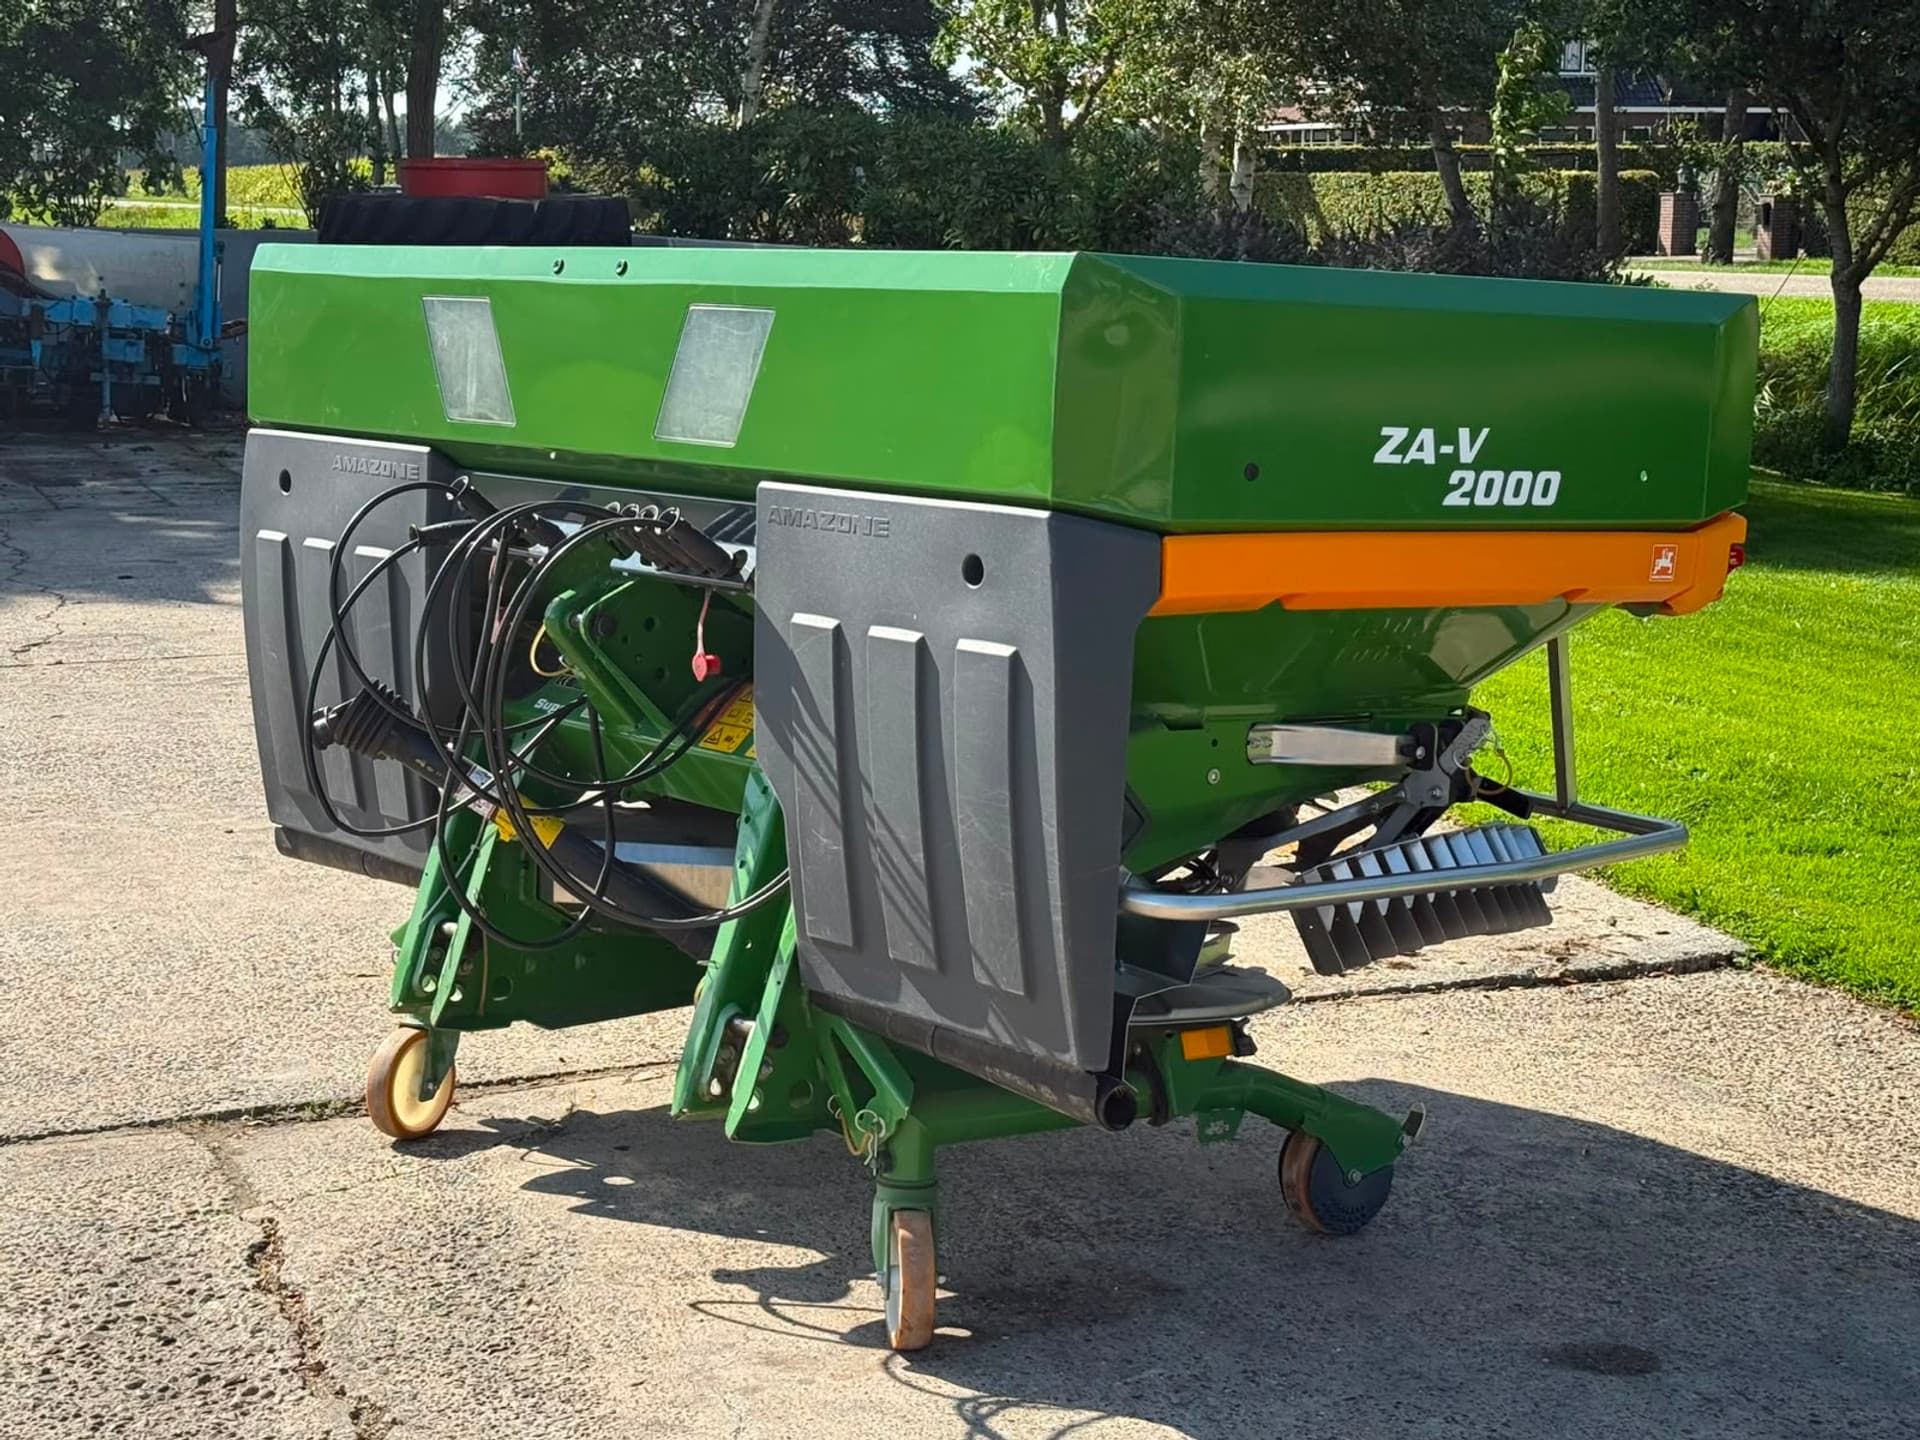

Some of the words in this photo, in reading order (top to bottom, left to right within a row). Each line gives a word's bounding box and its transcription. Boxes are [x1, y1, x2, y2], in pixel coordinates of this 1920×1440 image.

[1373, 426, 1490, 464] ZA-V
[331, 454, 420, 481] AMAZONE
[1442, 470, 1562, 506] 2000
[767, 504, 890, 538] AMAZONE
